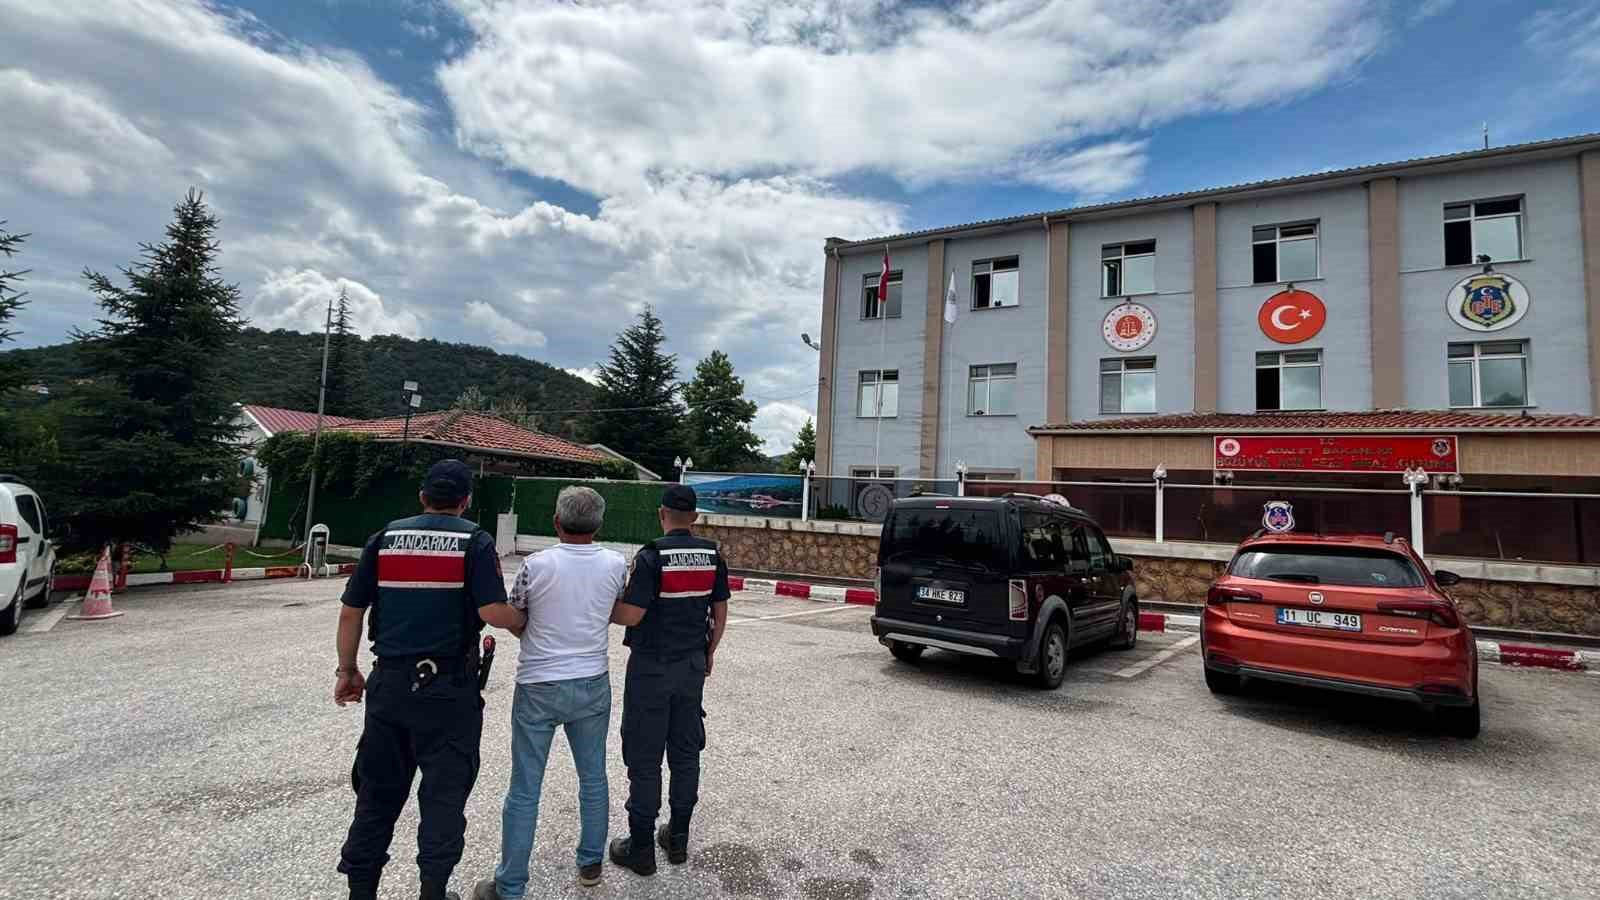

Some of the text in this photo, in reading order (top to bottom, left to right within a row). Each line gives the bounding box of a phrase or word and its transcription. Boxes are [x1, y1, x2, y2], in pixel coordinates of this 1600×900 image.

[389, 535, 459, 552] JANDARMA
[668, 553, 711, 567] JANDARMA
[919, 587, 929, 598] 34
[949, 591, 964, 602] 823
[1283, 610, 1358, 627] 11 UC 949
